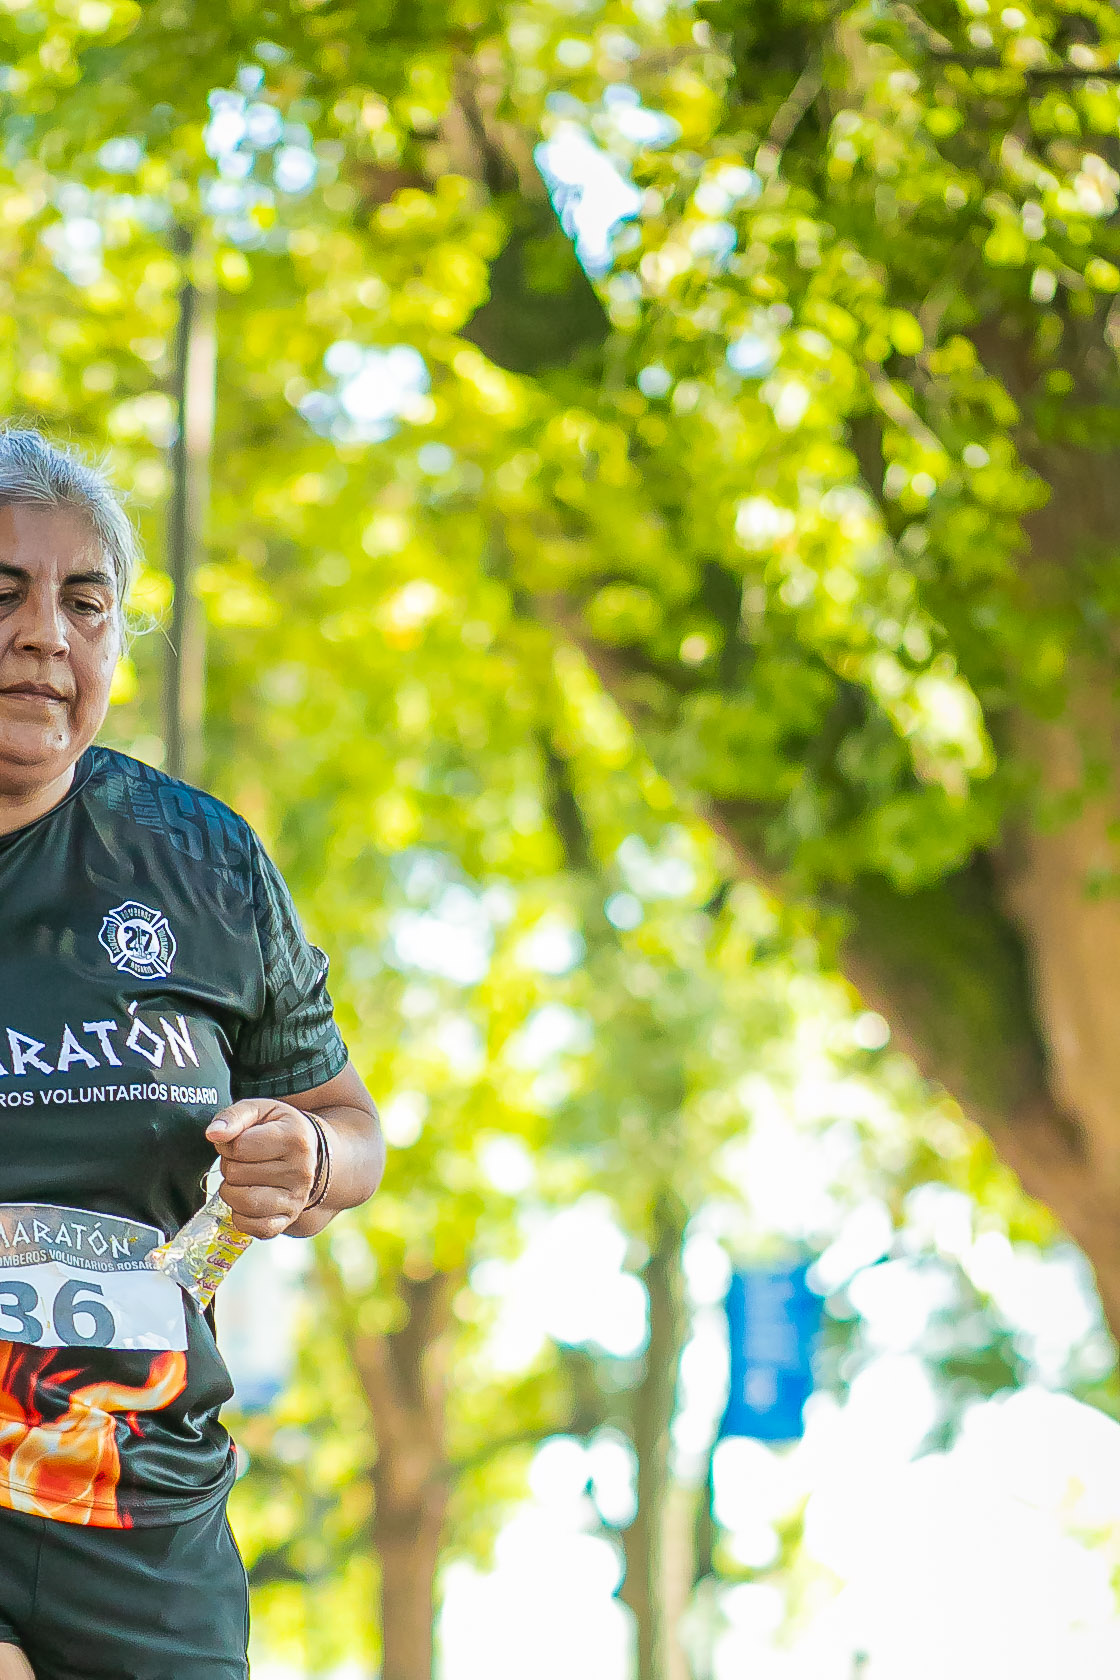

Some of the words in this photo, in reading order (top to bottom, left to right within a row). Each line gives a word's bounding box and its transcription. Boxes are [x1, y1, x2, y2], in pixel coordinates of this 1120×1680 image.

[123, 925, 153, 951] 27
[39, 1082, 168, 1105] VOLUNTARIOS
[170, 1085, 218, 1105] ROSARIO
[48, 1248, 115, 1272] VOLUNTARIOS
[116, 1260, 158, 1271] ROSAR
